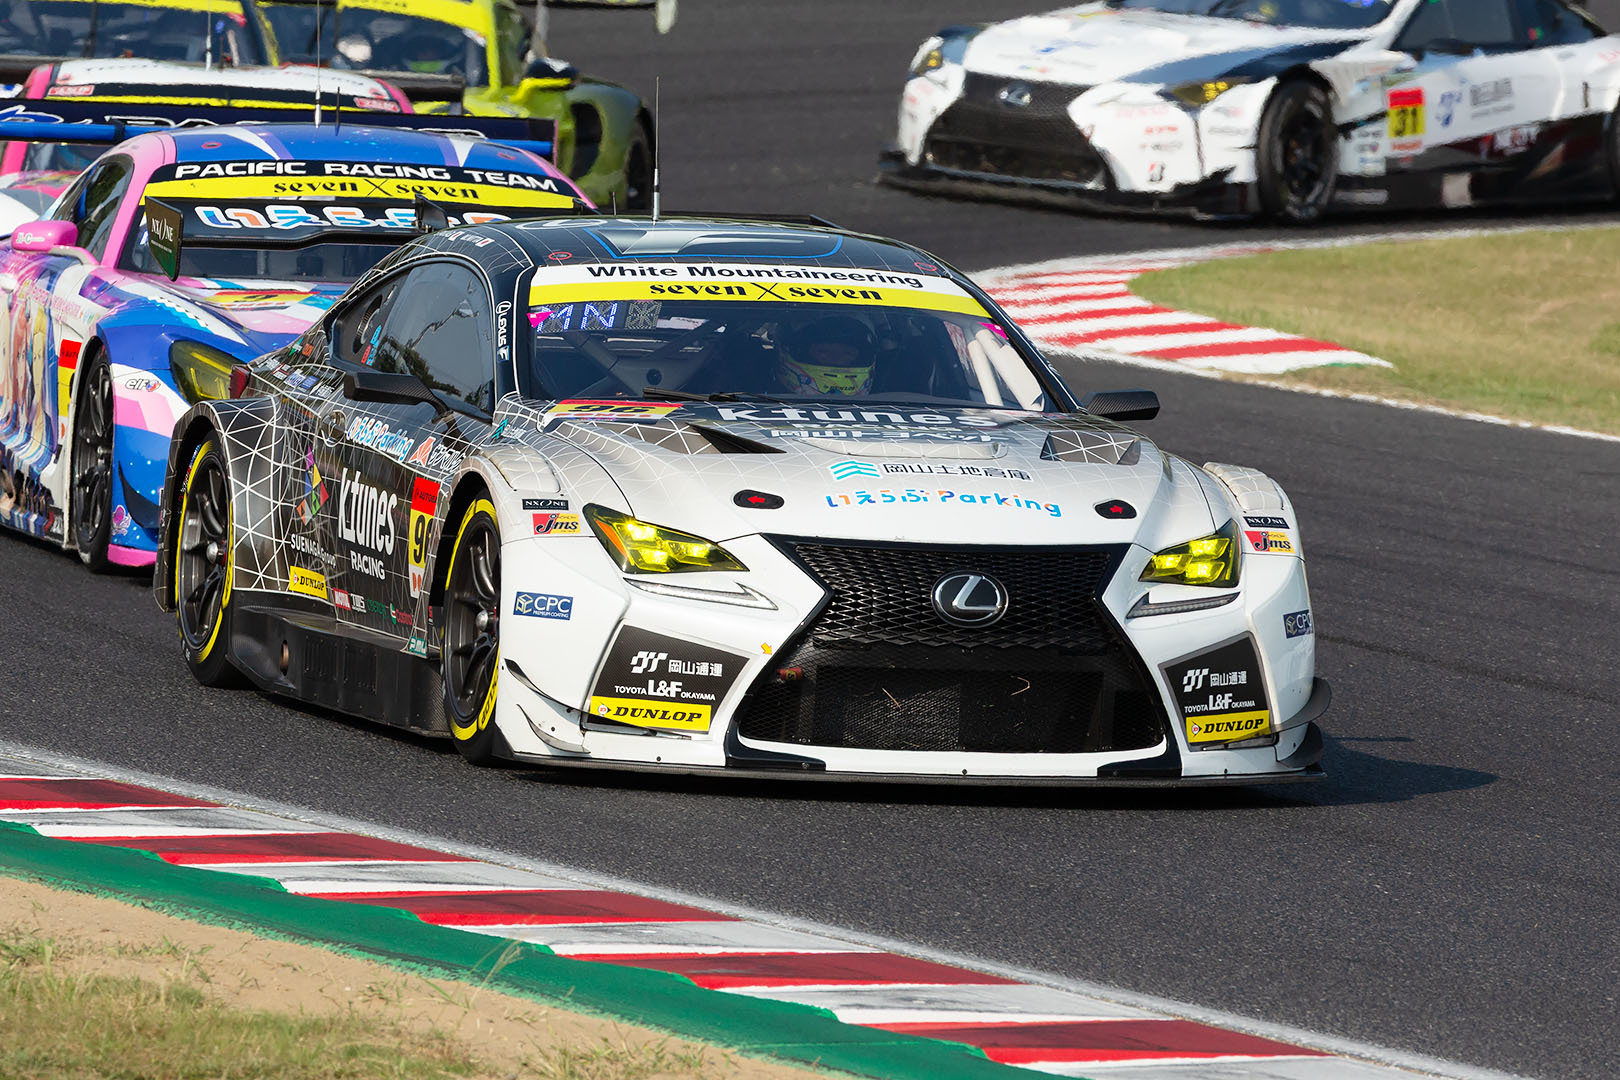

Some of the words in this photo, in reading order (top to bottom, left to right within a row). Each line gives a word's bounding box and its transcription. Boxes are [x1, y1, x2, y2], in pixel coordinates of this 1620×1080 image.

[175, 162, 306, 179] PACIFIC
[323, 163, 450, 181] RACING
[464, 169, 558, 192] TEAM
[274, 179, 359, 194] seven
[396, 182, 480, 200] seven
[586, 266, 682, 279] White
[687, 266, 924, 288] Mountaineering
[649, 283, 747, 297] seven
[789, 285, 883, 301] seven
[498, 312, 508, 347] LEXUS
[568, 405, 656, 413] 96
[883, 463, 1034, 481] 岡山土地倉庫
[826, 489, 928, 508] いえらぶ
[940, 489, 1062, 518] Parking
[350, 550, 386, 580] RACING
[300, 575, 325, 591] DUNLOP
[534, 596, 571, 613] CPC
[668, 659, 723, 677] 岡山通運
[615, 685, 647, 695] TOYOTA
[648, 680, 682, 697] L&F
[681, 691, 716, 700] OKAYAMA
[1184, 704, 1208, 713] TOYOTA
[1209, 693, 1233, 711] L&F
[1231, 700, 1256, 709] OKAYAMA
[613, 706, 702, 722] DUNLOP
[1203, 719, 1264, 734] DUNLOP
